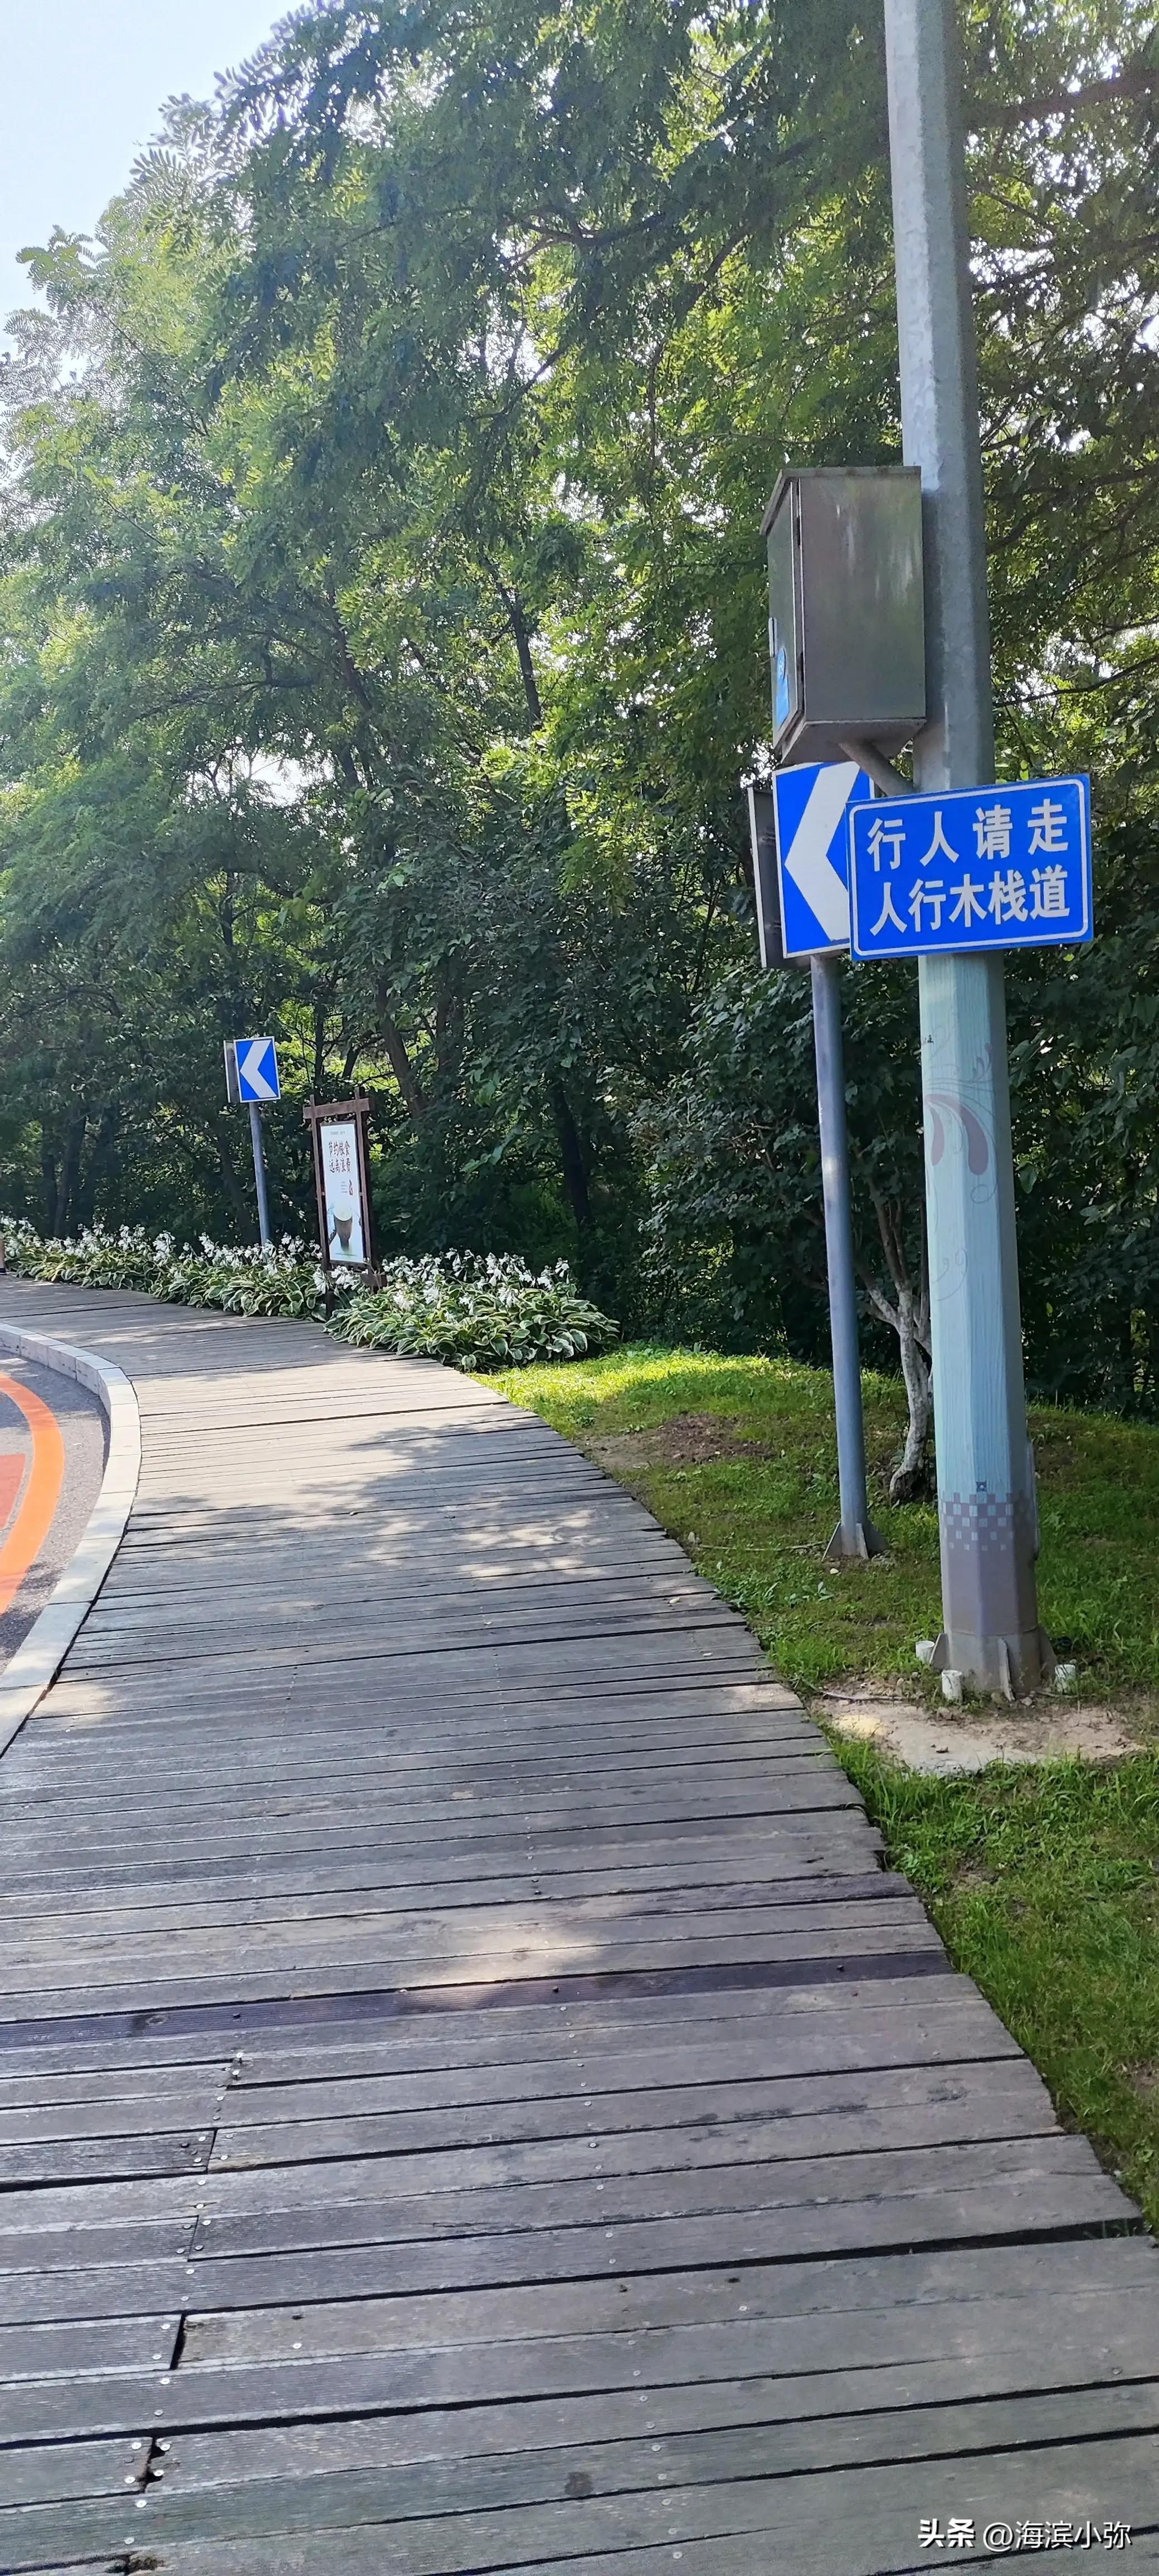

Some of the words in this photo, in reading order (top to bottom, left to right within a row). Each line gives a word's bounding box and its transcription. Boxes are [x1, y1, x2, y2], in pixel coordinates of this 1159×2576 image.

[867, 798, 1069, 872] 行人请走
[869, 864, 1070, 936] 人行木栈道
